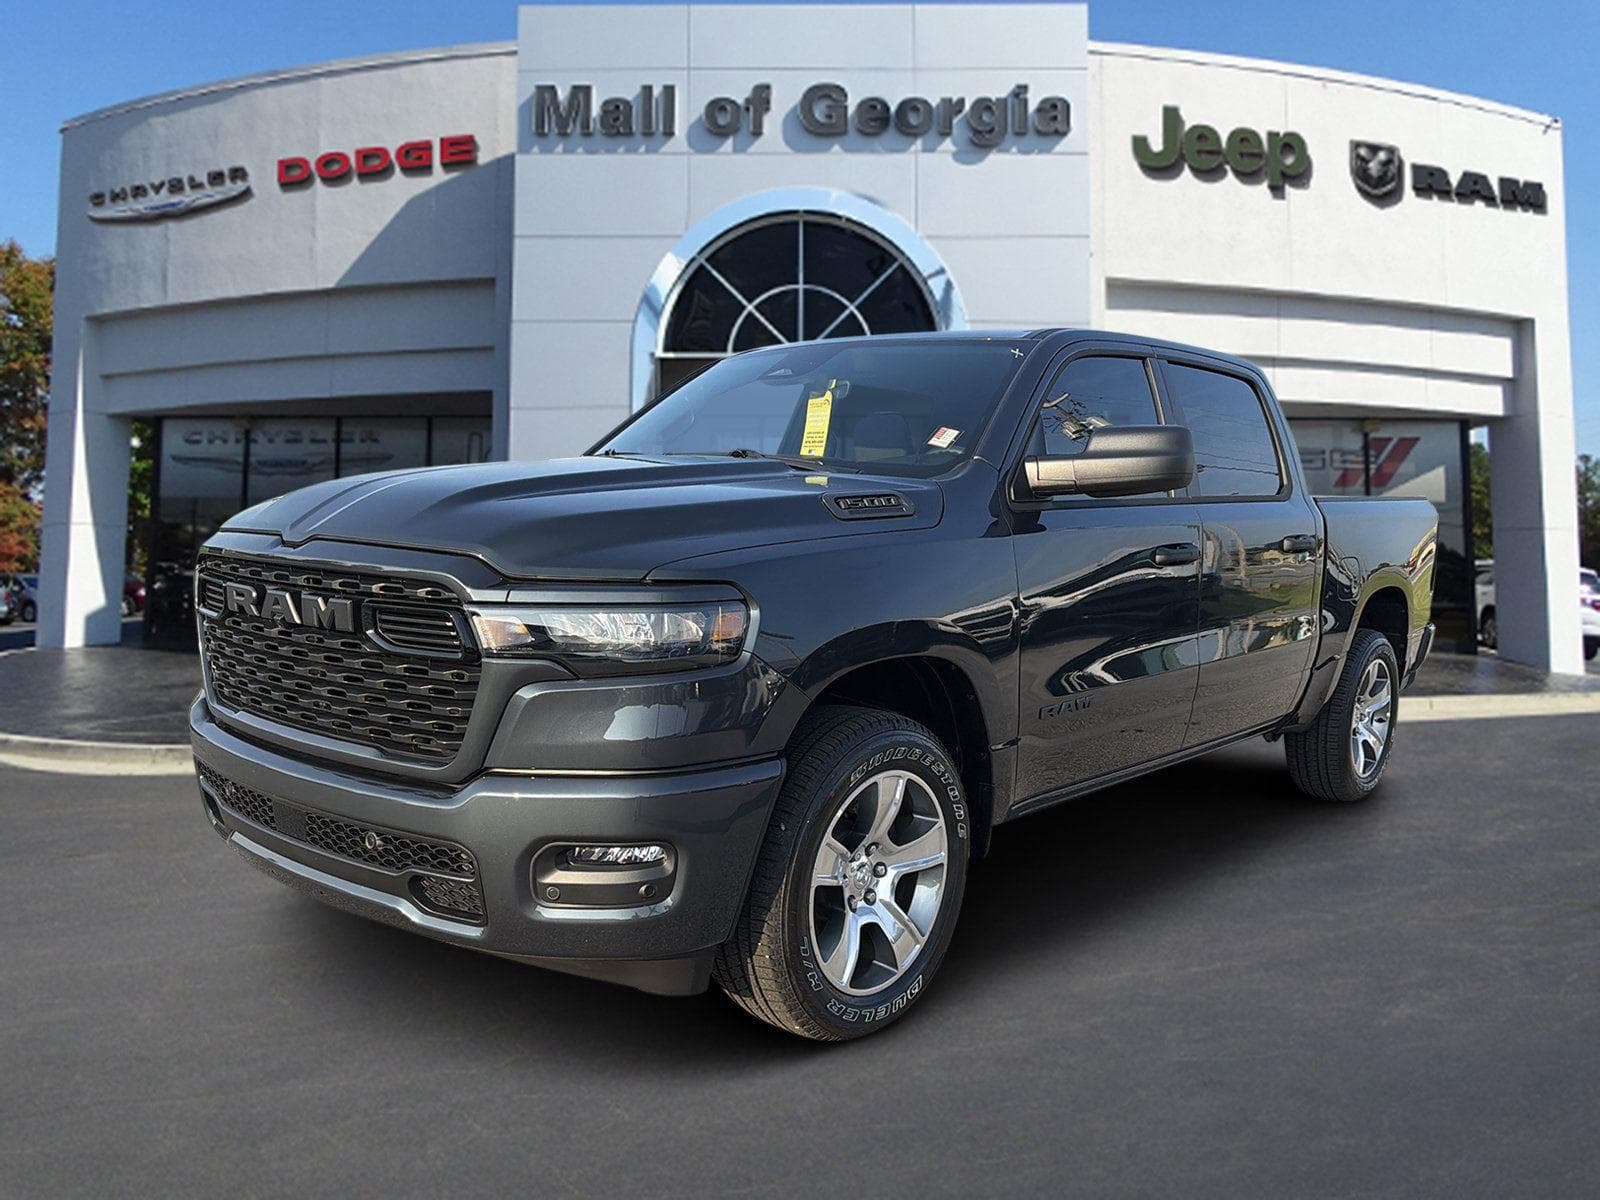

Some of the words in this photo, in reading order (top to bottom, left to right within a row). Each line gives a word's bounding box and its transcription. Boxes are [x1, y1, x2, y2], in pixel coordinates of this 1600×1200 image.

[533, 84, 676, 137] Mall
[704, 83, 772, 137] of
[800, 83, 1072, 148] Georgia
[277, 134, 478, 184] DODGE
[1131, 105, 1309, 188] Jeep
[89, 166, 249, 207] CHRYSLER
[1410, 163, 1547, 212] RAM
[836, 496, 901, 510] 1500
[225, 581, 354, 632] RAM
[1038, 696, 1092, 720] RAM
[849, 746, 968, 840] BRIDGESTONE
[826, 974, 923, 1022] DUELER
